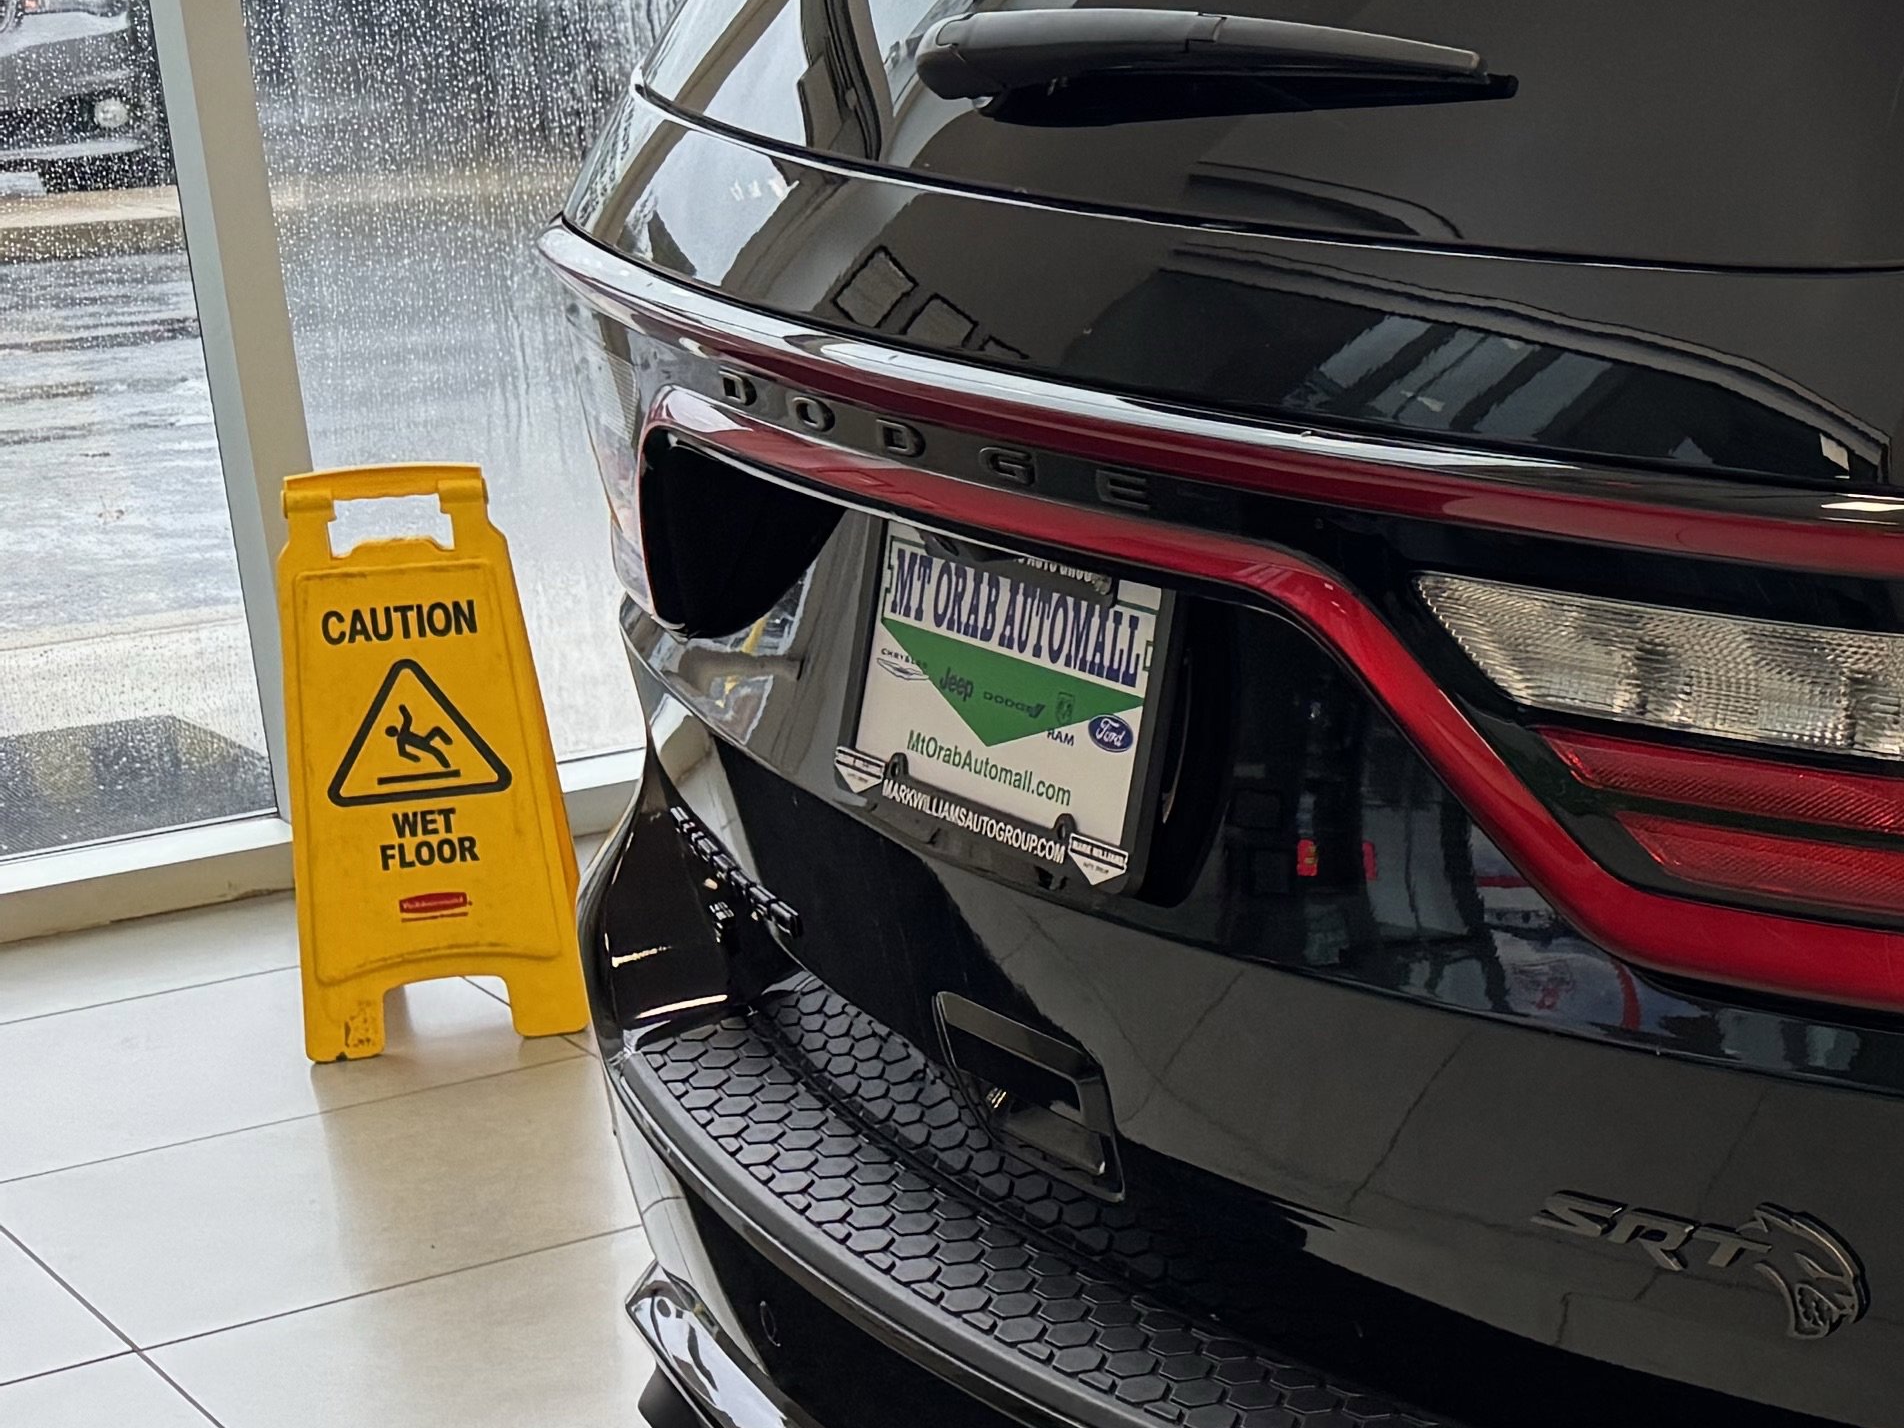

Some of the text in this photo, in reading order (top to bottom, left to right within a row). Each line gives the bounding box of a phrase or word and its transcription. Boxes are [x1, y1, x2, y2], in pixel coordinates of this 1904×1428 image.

[719, 369, 1152, 510] DODGE
[321, 598, 478, 646] CAUTION
[891, 548, 1141, 688] MT ORAB AUTOMALL
[939, 667, 974, 702] Jeep
[1047, 729, 1075, 747] RAM
[1095, 717, 1127, 747] Ford
[906, 729, 1073, 806] MtOrabAutomall.com
[391, 808, 457, 839] WET
[882, 778, 1066, 864] MARKWILLIAMSAUTOGROUP.COM
[380, 836, 480, 871] FLOOR
[1529, 1189, 1773, 1272] SRT
